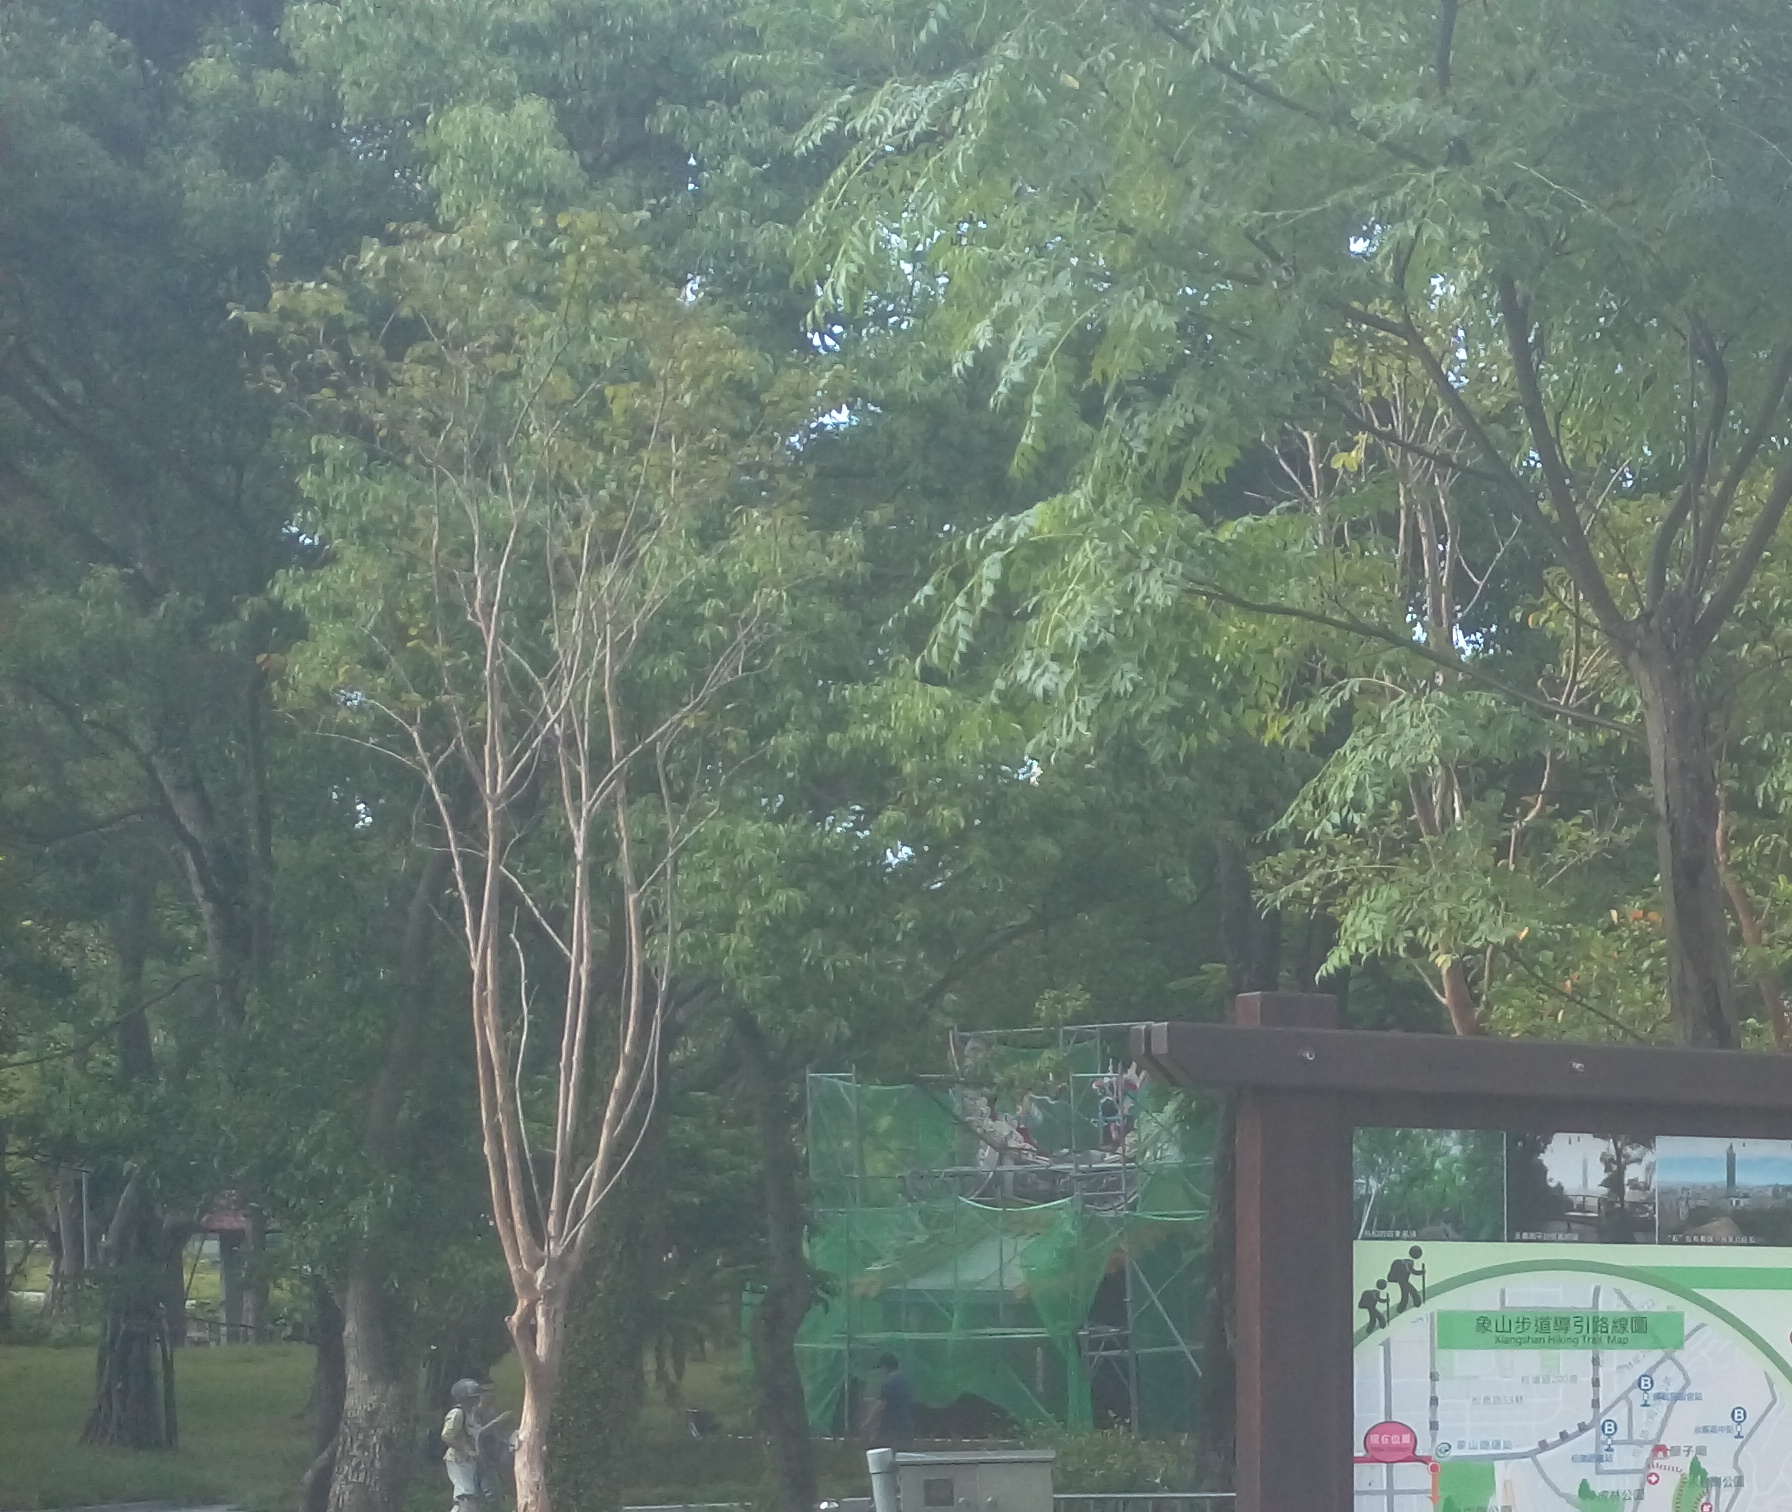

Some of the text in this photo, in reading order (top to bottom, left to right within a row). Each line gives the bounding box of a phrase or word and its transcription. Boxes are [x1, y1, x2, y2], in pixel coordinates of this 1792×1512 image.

[1475, 1315, 1648, 1334] 象山步道導引路線圖
[1494, 1335, 1629, 1346] Xiangshan Hiking Trail Map
